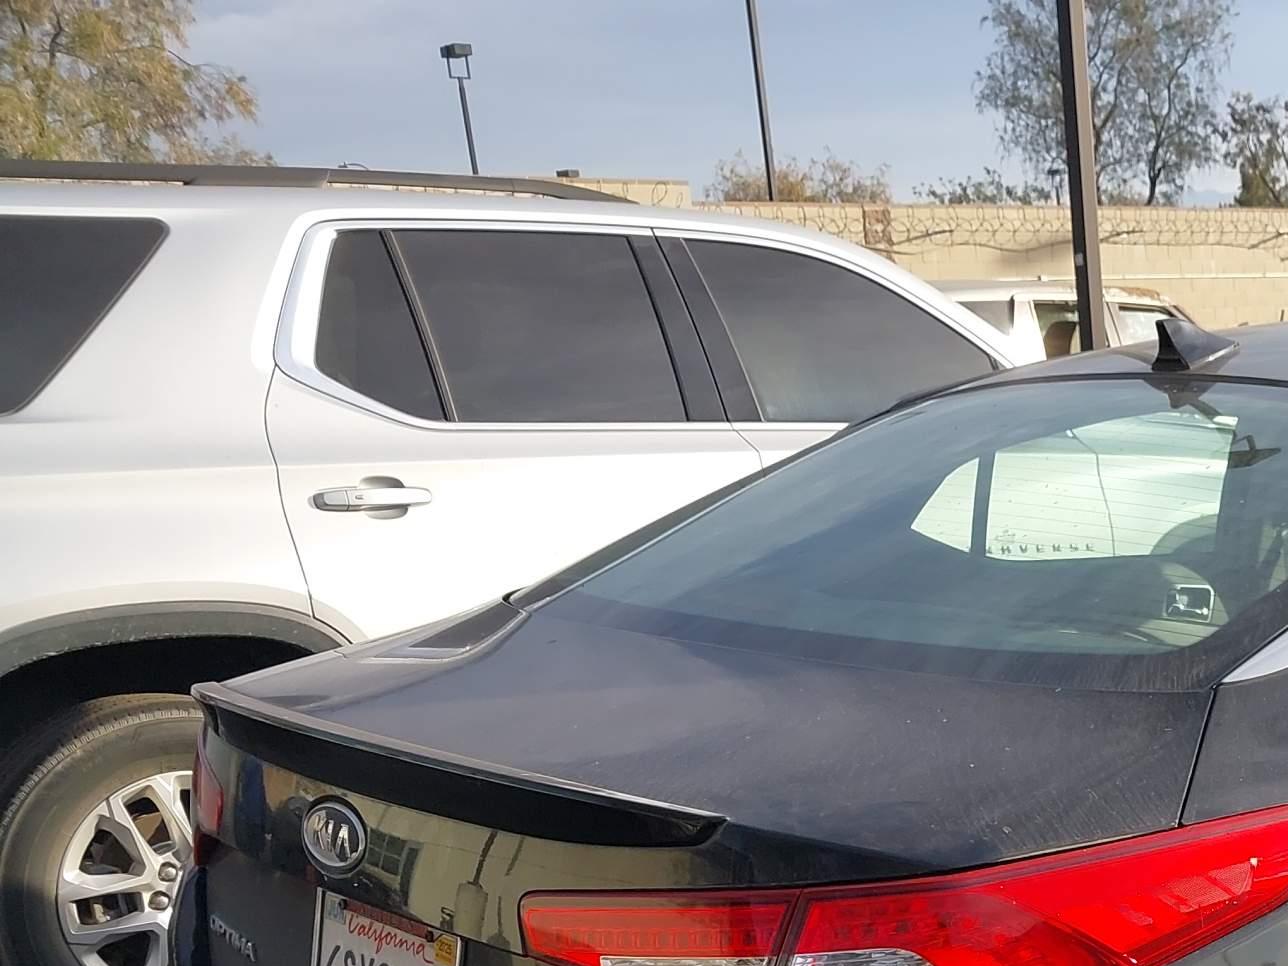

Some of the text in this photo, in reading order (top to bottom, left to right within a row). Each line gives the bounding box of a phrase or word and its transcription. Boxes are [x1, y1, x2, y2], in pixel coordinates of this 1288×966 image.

[314, 810, 351, 858] KIA
[209, 914, 256, 962] OPTIMA
[348, 911, 434, 965] California
